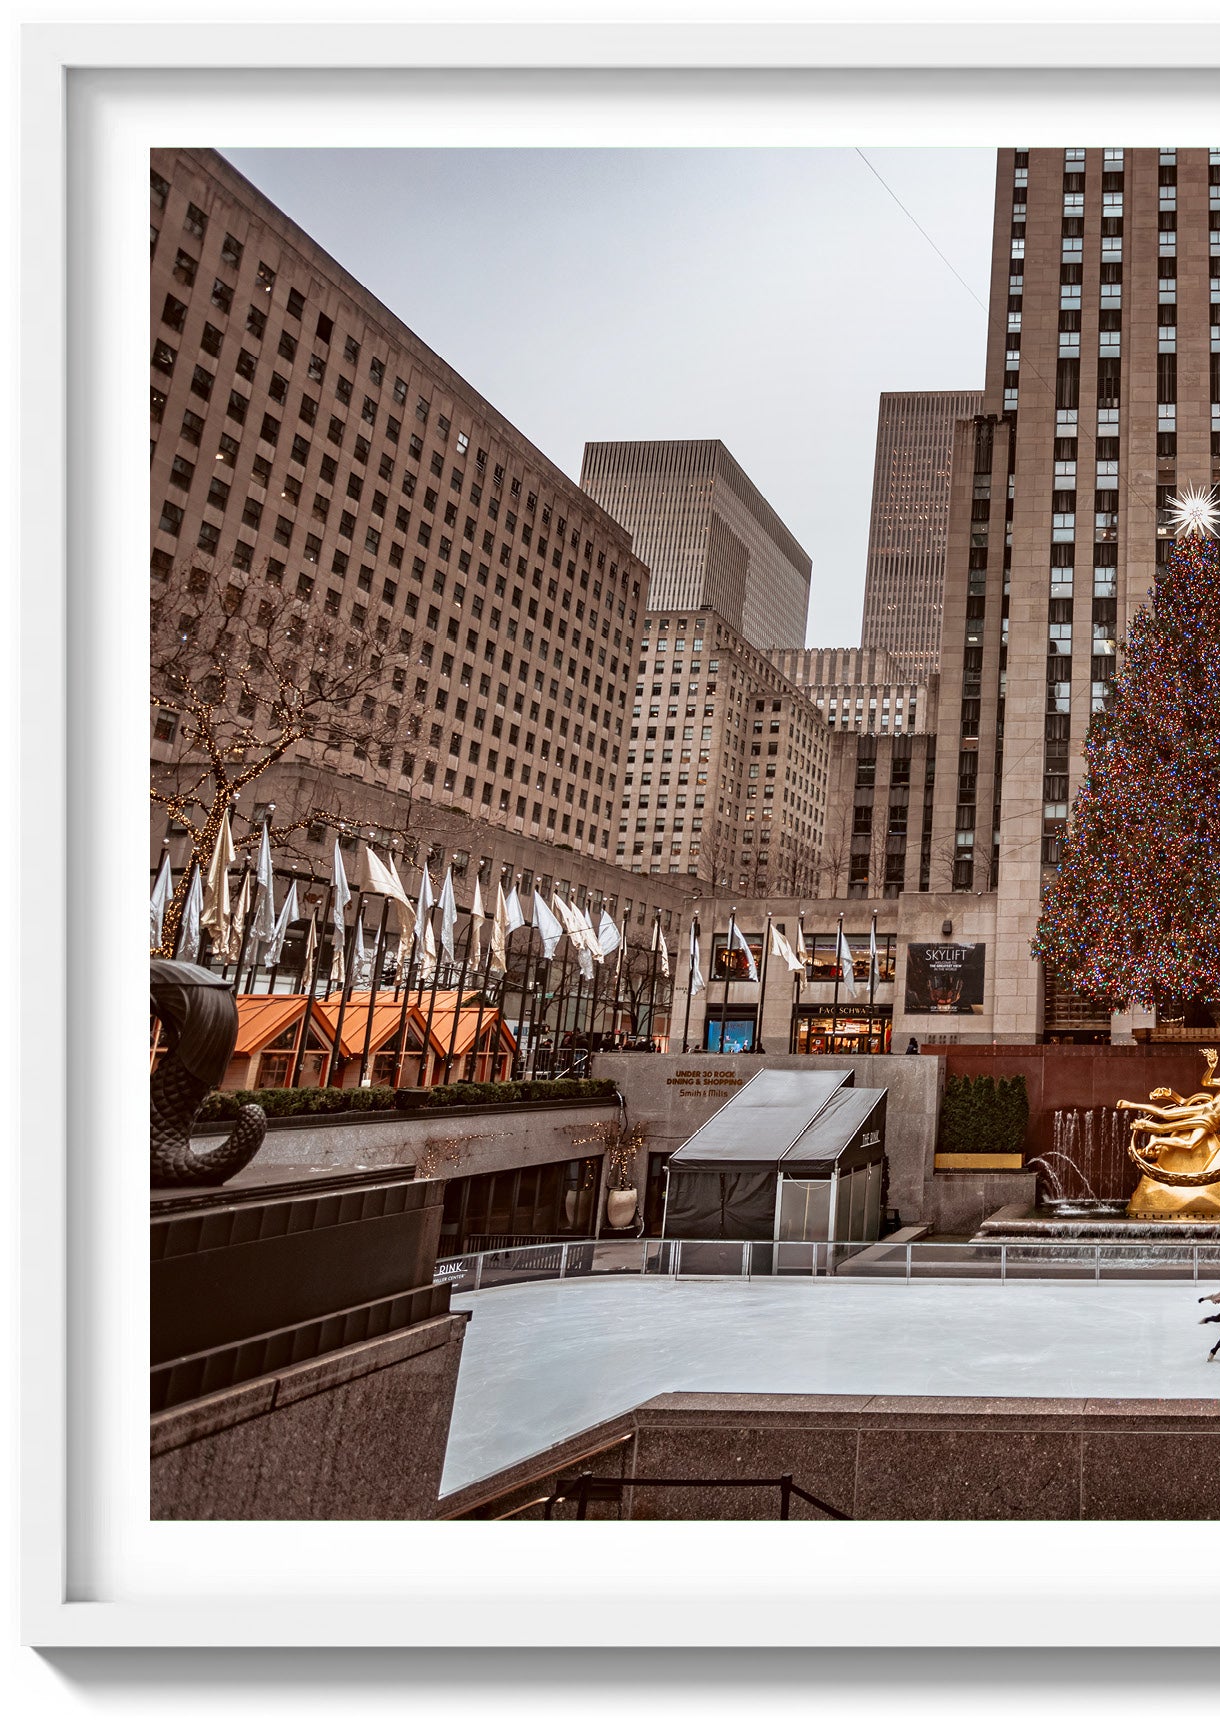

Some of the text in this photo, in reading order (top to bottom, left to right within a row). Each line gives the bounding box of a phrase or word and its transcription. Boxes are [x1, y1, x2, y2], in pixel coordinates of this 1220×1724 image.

[925, 949, 967, 961] SKYLIFT
[680, 1089, 701, 1097] Smith
[439, 1262, 463, 1275] RINK
